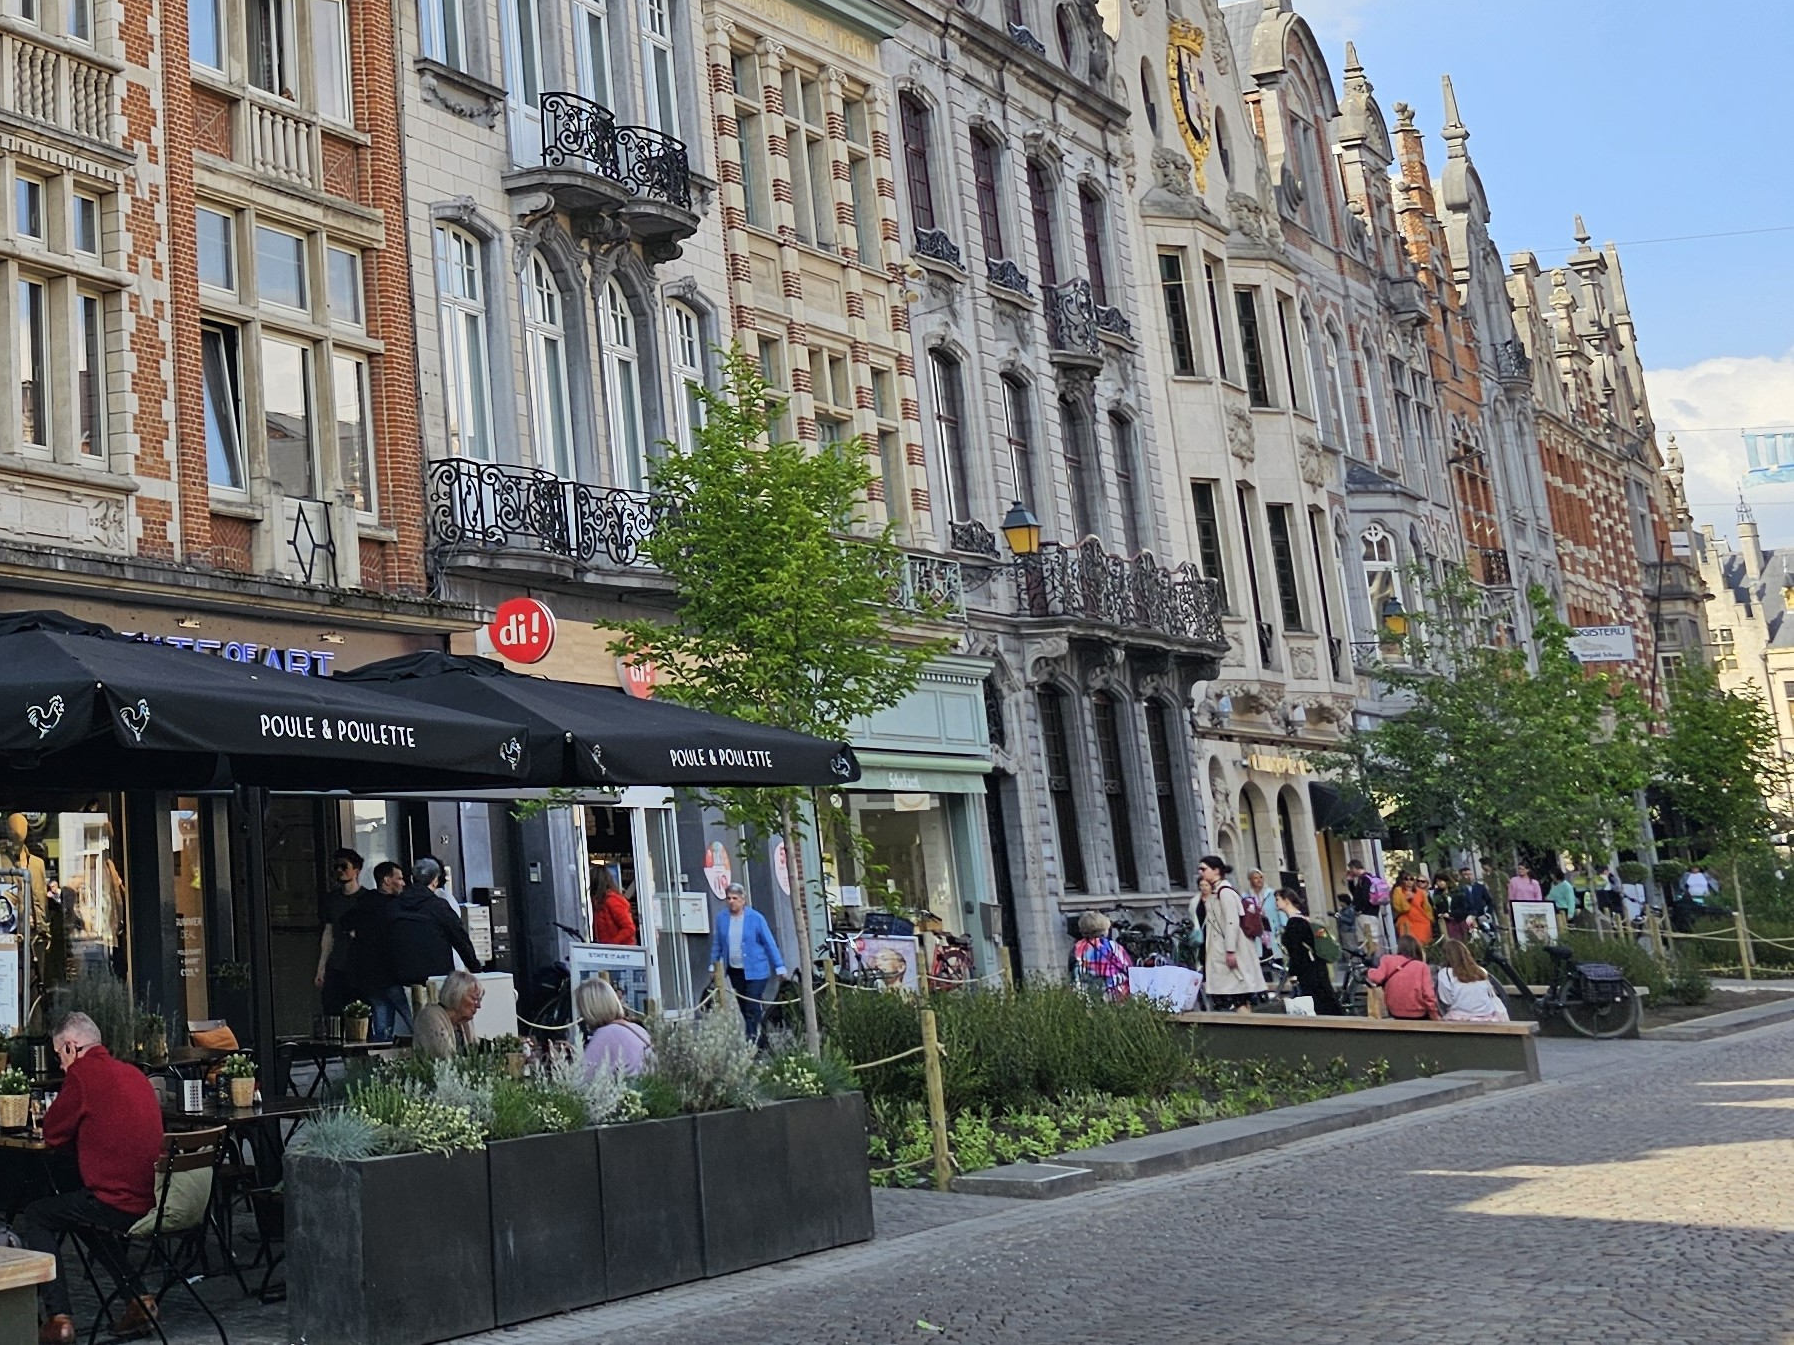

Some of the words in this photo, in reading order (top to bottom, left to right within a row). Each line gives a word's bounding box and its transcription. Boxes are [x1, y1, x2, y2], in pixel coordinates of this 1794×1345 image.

[499, 611, 540, 646] di!
[264, 647, 335, 677] ART
[260, 714, 316, 739] POULE
[321, 718, 332, 740] &
[337, 719, 416, 748] POULETTE
[669, 749, 706, 767] POULE
[708, 749, 717, 766] &
[718, 748, 773, 768] POULETTE
